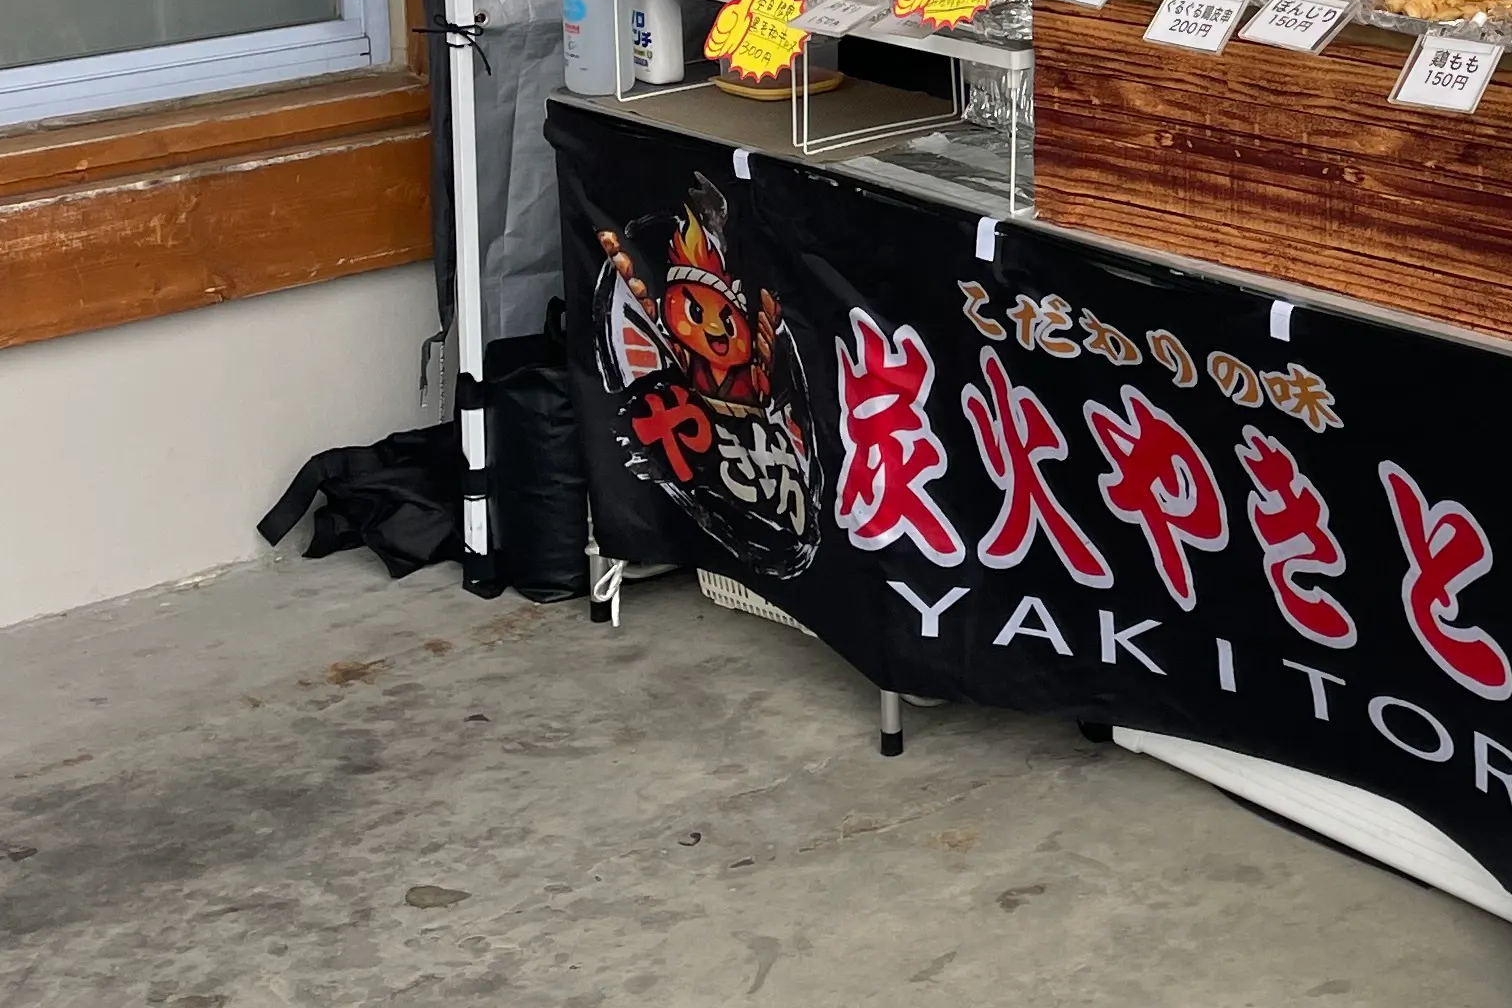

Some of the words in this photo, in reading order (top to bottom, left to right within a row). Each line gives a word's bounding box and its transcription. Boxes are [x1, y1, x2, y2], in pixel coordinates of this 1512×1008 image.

[1272, 0, 1338, 23] ぼんじり
[1168, 18, 1213, 38] 200円
[1267, 14, 1314, 33] 150円
[1428, 50, 1480, 73] 鶏もも
[1424, 70, 1470, 91] 150円
[957, 280, 1345, 434] こだわりの味
